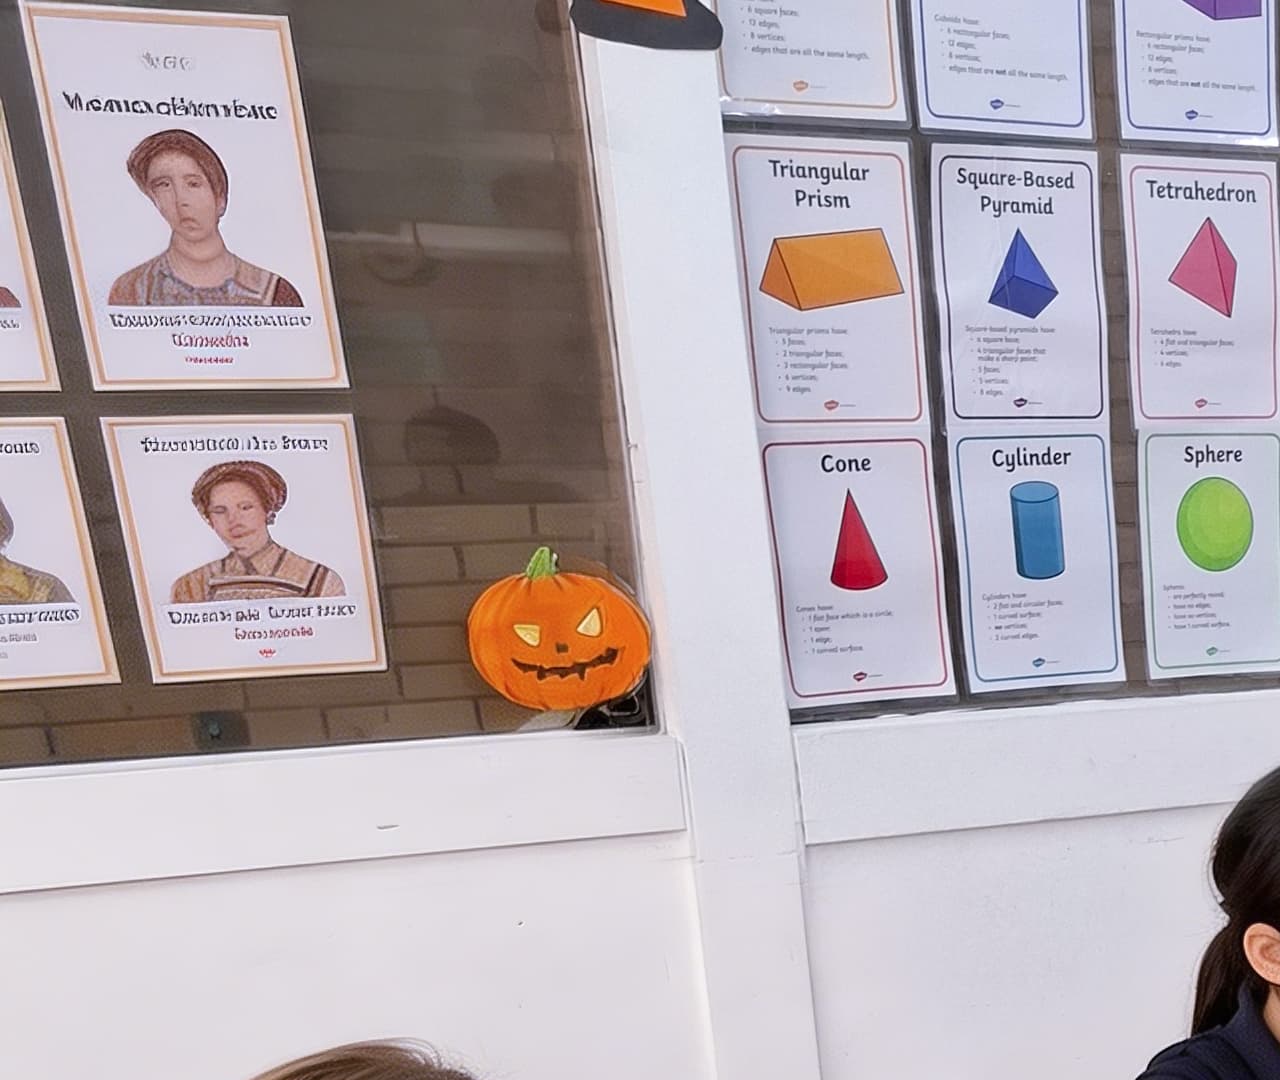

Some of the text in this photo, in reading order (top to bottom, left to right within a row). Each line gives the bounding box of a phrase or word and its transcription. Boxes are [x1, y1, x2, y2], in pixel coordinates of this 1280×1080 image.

[768, 160, 870, 183] Triangular
[956, 168, 1075, 190] Square-Based
[795, 189, 850, 209] Prism
[1146, 180, 1257, 203] Tetrahedron
[980, 196, 1054, 218] Pyramid
[821, 455, 872, 472] Cone
[992, 447, 1071, 471] Cylinder
[1184, 445, 1243, 467] Sphere
